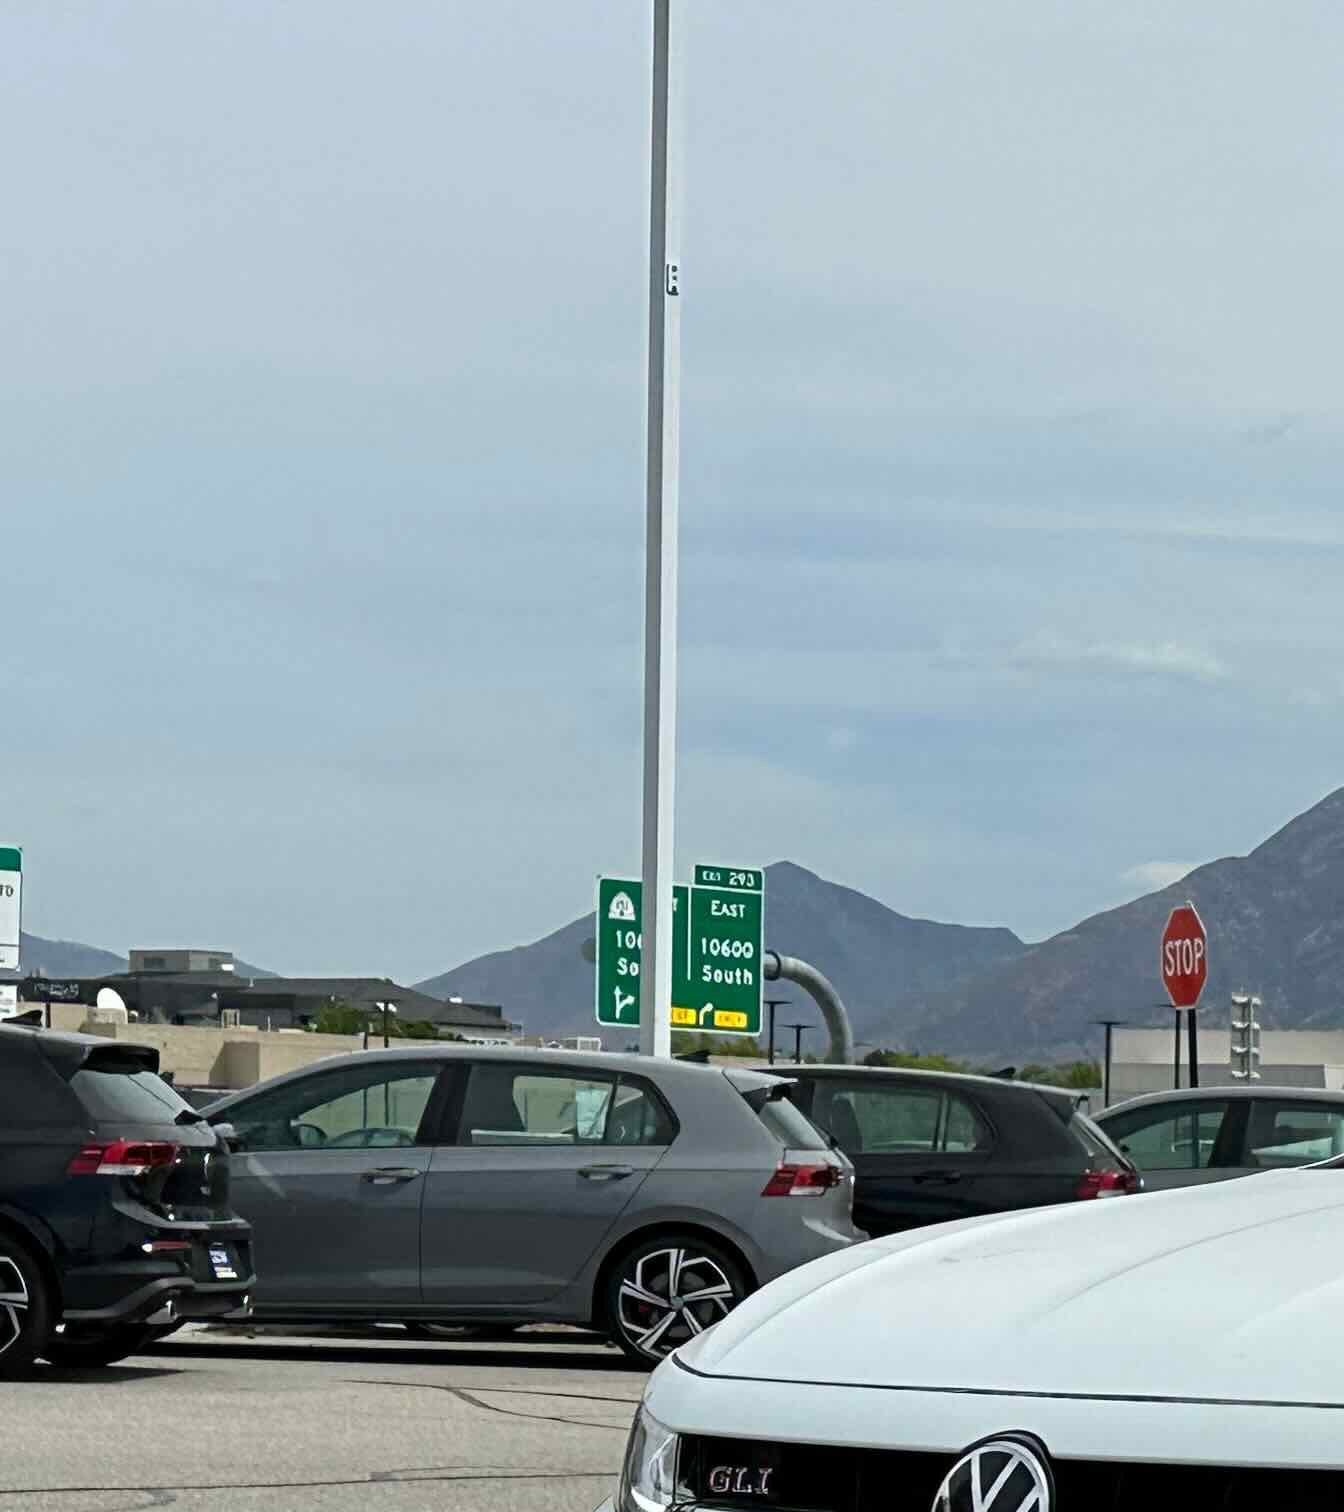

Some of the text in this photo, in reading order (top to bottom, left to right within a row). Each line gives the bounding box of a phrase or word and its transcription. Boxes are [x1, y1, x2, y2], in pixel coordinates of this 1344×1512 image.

[729, 872, 754, 888] 293
[711, 900, 746, 919] EAST
[701, 937, 754, 959] 10600
[1165, 938, 1204, 977] STOP
[701, 965, 753, 985] South
[709, 1466, 773, 1496] GLI
